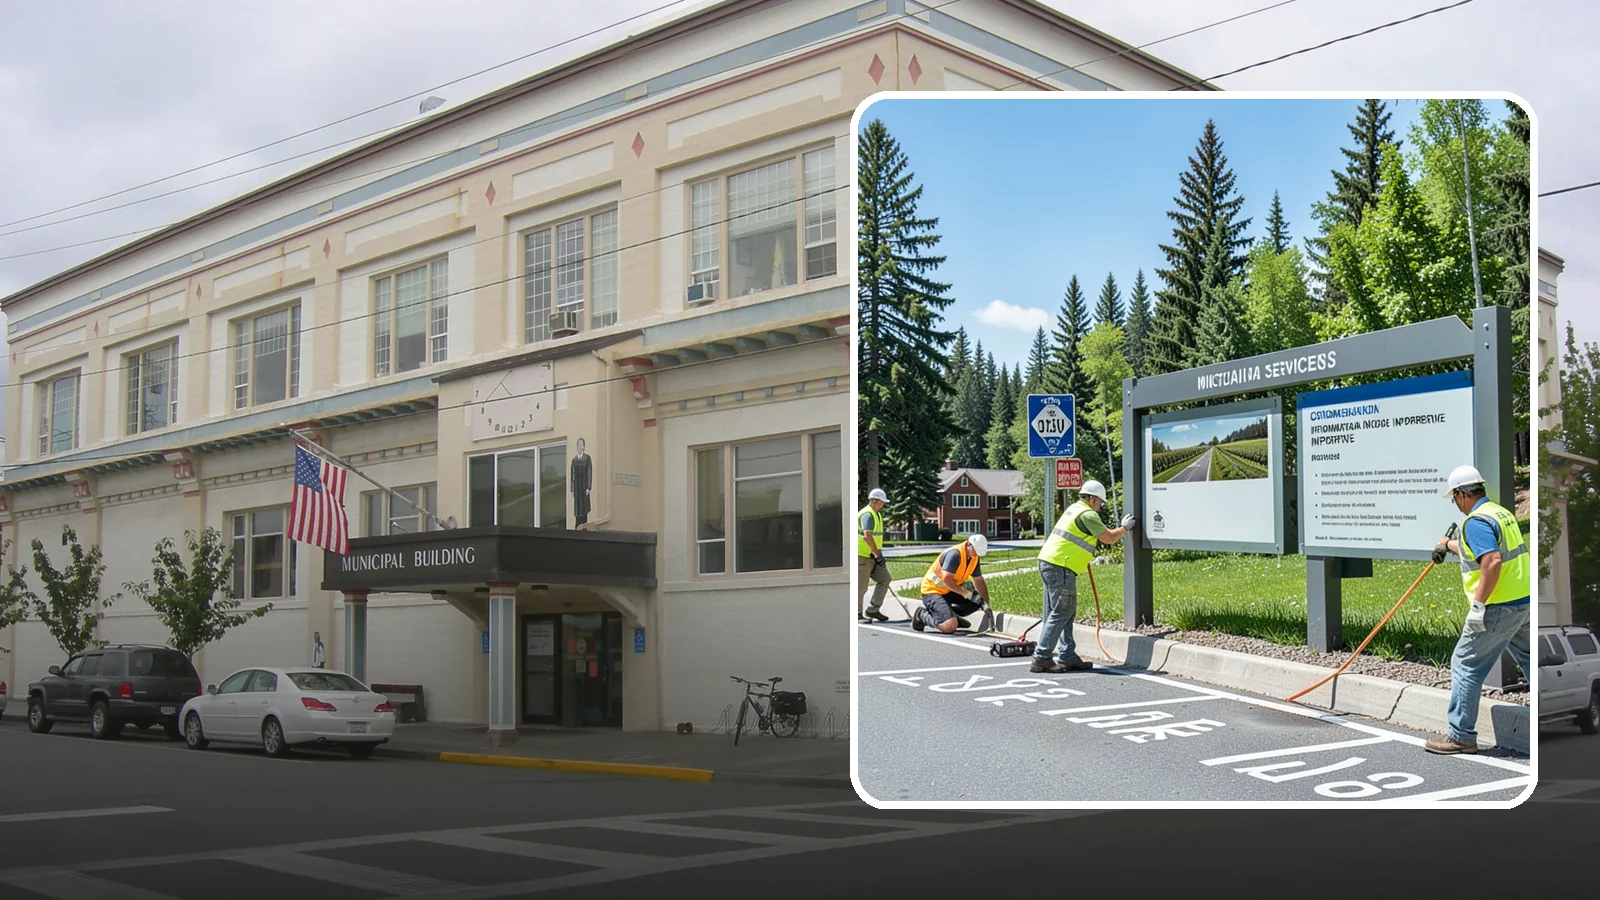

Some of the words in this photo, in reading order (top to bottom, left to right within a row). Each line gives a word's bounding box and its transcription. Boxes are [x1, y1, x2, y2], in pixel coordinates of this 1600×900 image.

[475, 390, 479, 398] 7
[481, 407, 485, 415] 8
[488, 417, 492, 426] 9
[494, 423, 500, 432] 10
[507, 425, 513, 433] 12
[521, 420, 525, 428] 2
[529, 414, 533, 422] 3
[536, 402, 540, 410] 4
[342, 552, 405, 572] MUNICIPAL
[414, 546, 475, 567] BUILDING
